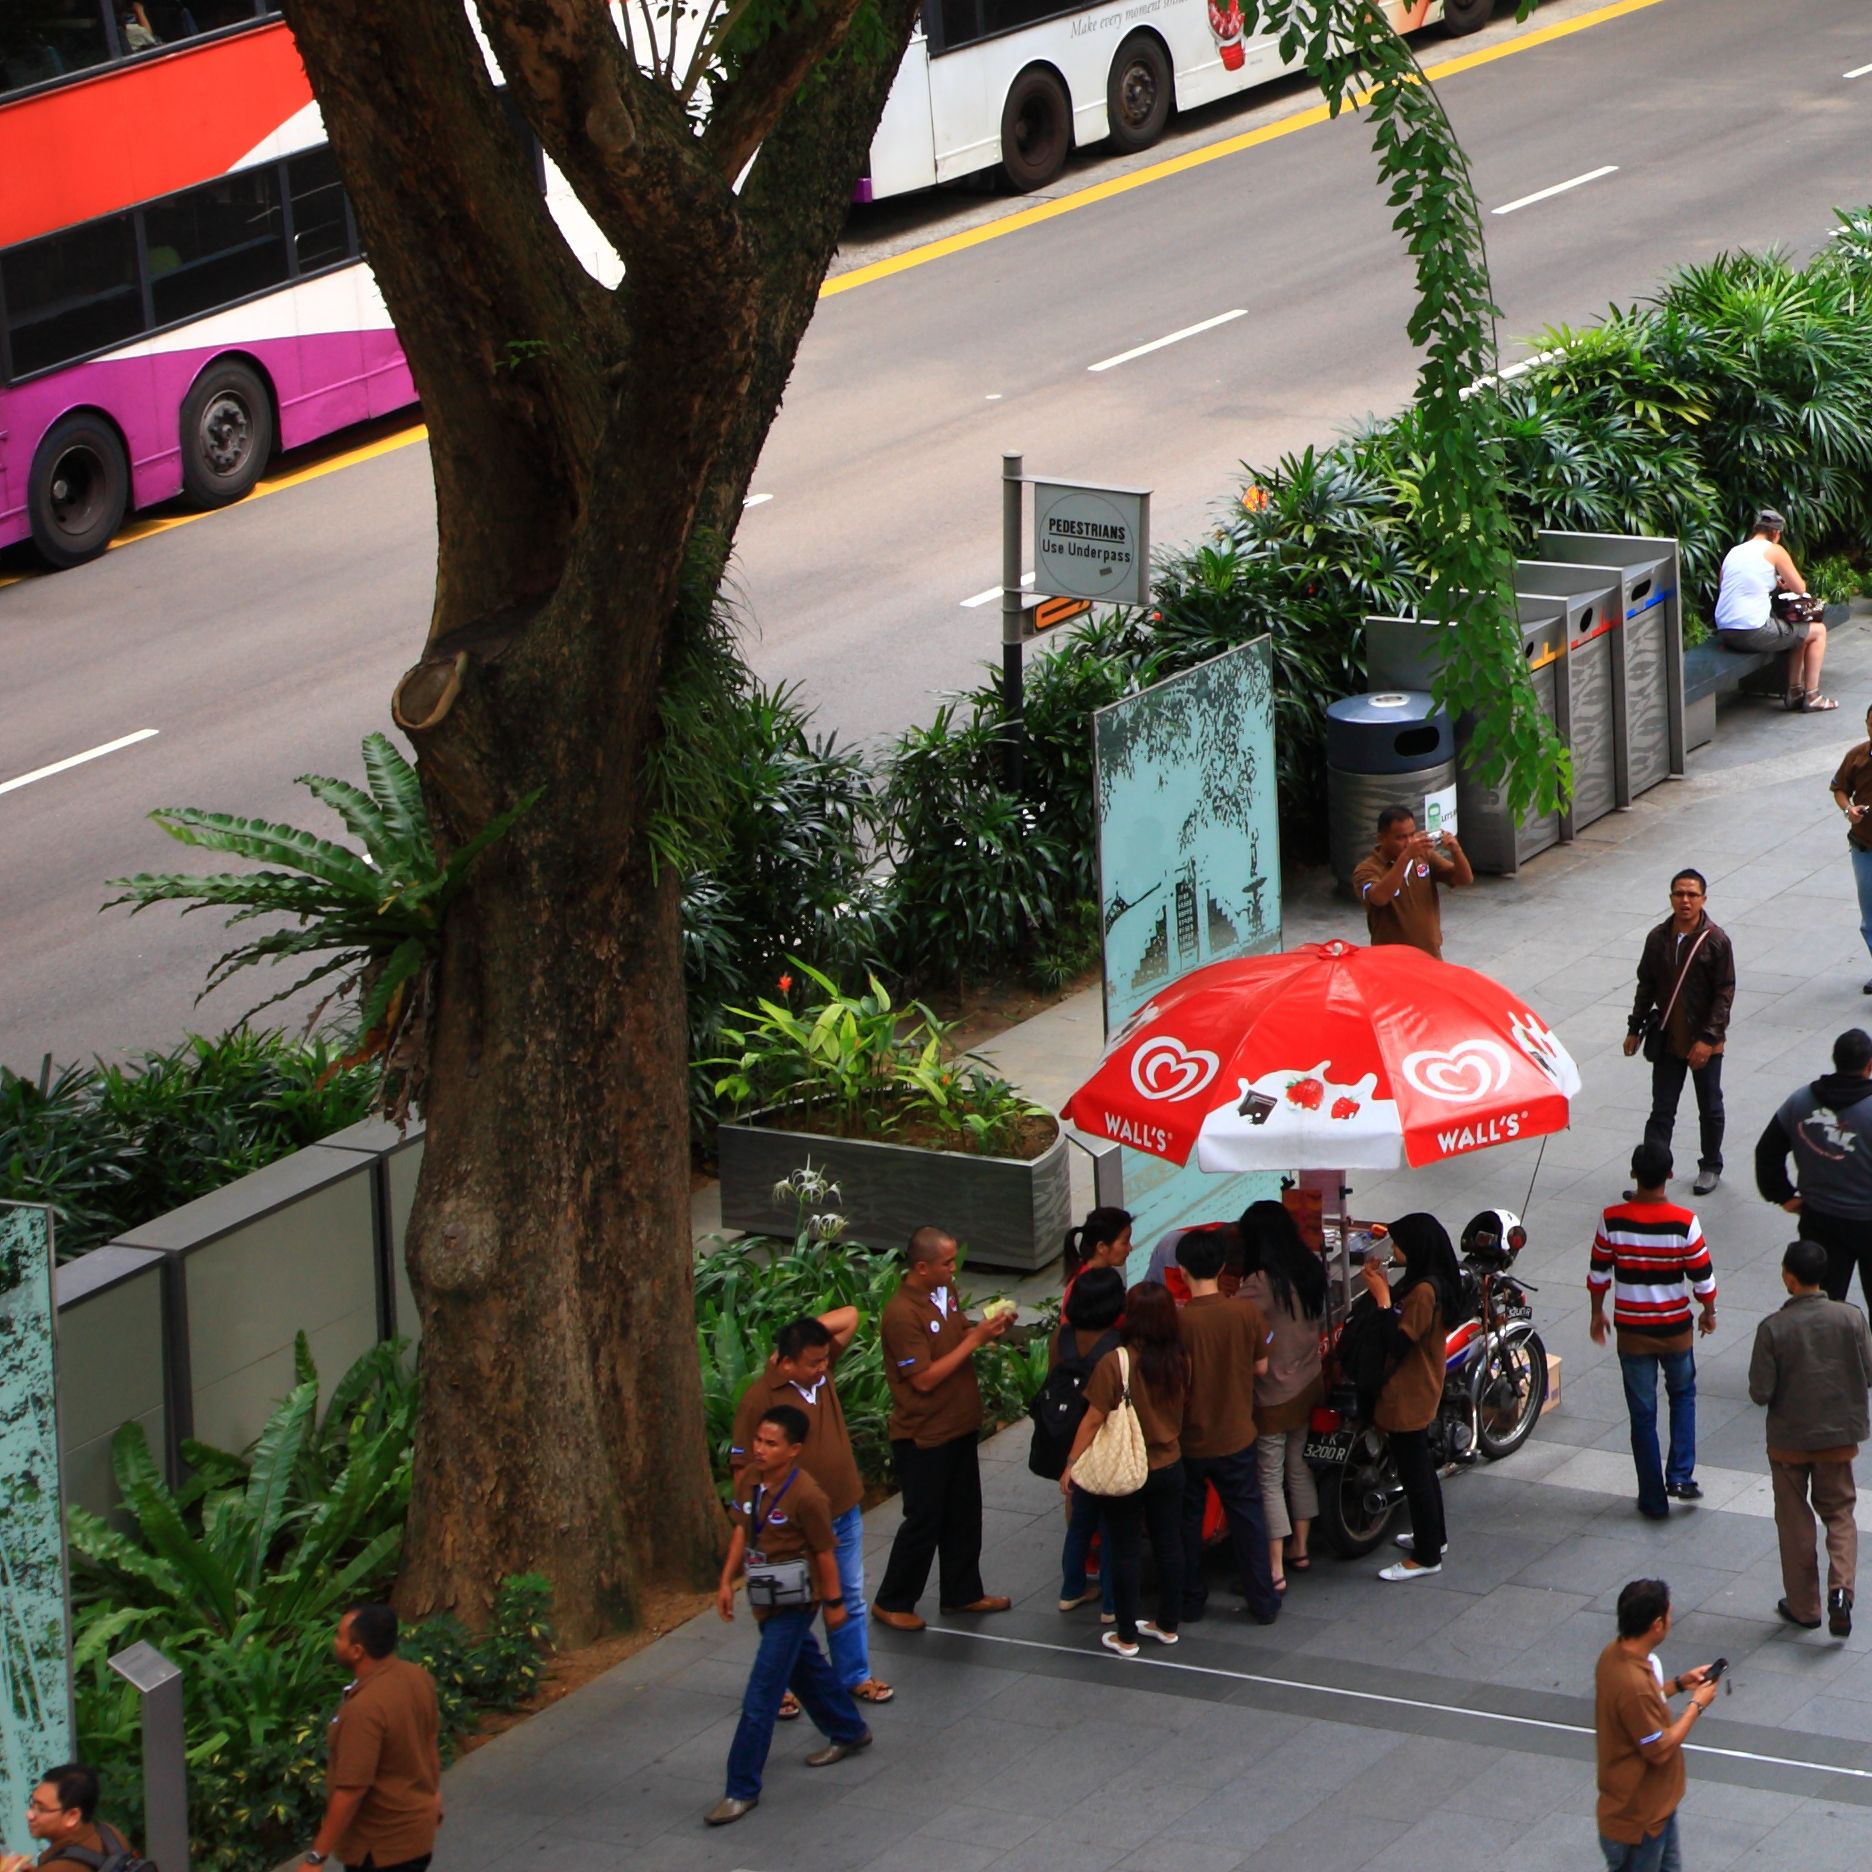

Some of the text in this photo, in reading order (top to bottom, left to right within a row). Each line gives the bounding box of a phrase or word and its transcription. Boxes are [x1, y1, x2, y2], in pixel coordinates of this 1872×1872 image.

[1070, 20, 1098, 39] Make
[1099, 12, 1123, 30] every
[1125, 0, 1161, 21] moment
[1048, 517, 1126, 541] PEDESTRIANS
[1042, 538, 1131, 564] Use Underpass
[1104, 1110, 1167, 1153] WALL'S
[1437, 1111, 1520, 1155] WALL'S
